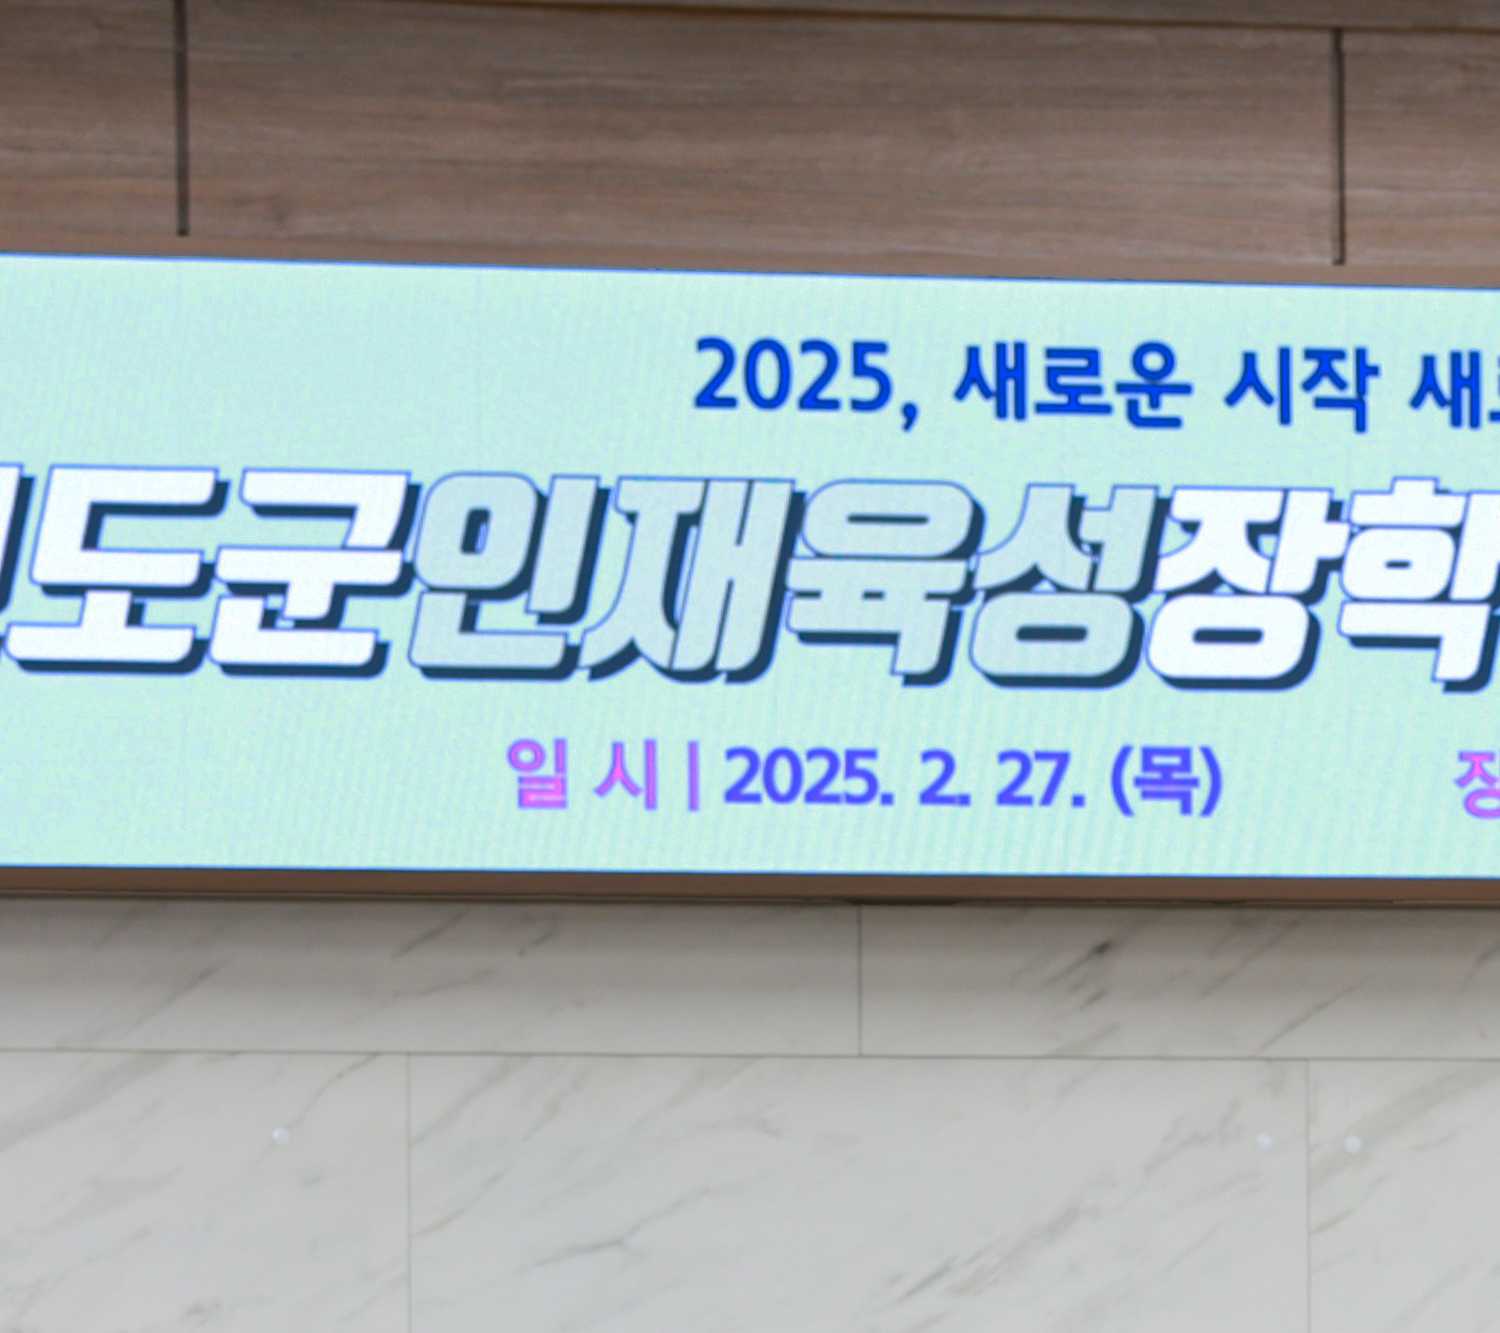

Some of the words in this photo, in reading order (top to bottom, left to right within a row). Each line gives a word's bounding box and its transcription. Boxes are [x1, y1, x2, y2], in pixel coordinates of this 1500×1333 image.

[695, 337, 918, 431] 2025,
[953, 341, 1192, 429] 새로운
[1224, 346, 1380, 433] 시작
[724, 746, 894, 806] 2025.
[919, 749, 971, 807] 2.
[996, 749, 1086, 808] 27.
[1110, 744, 1223, 817] (목)
